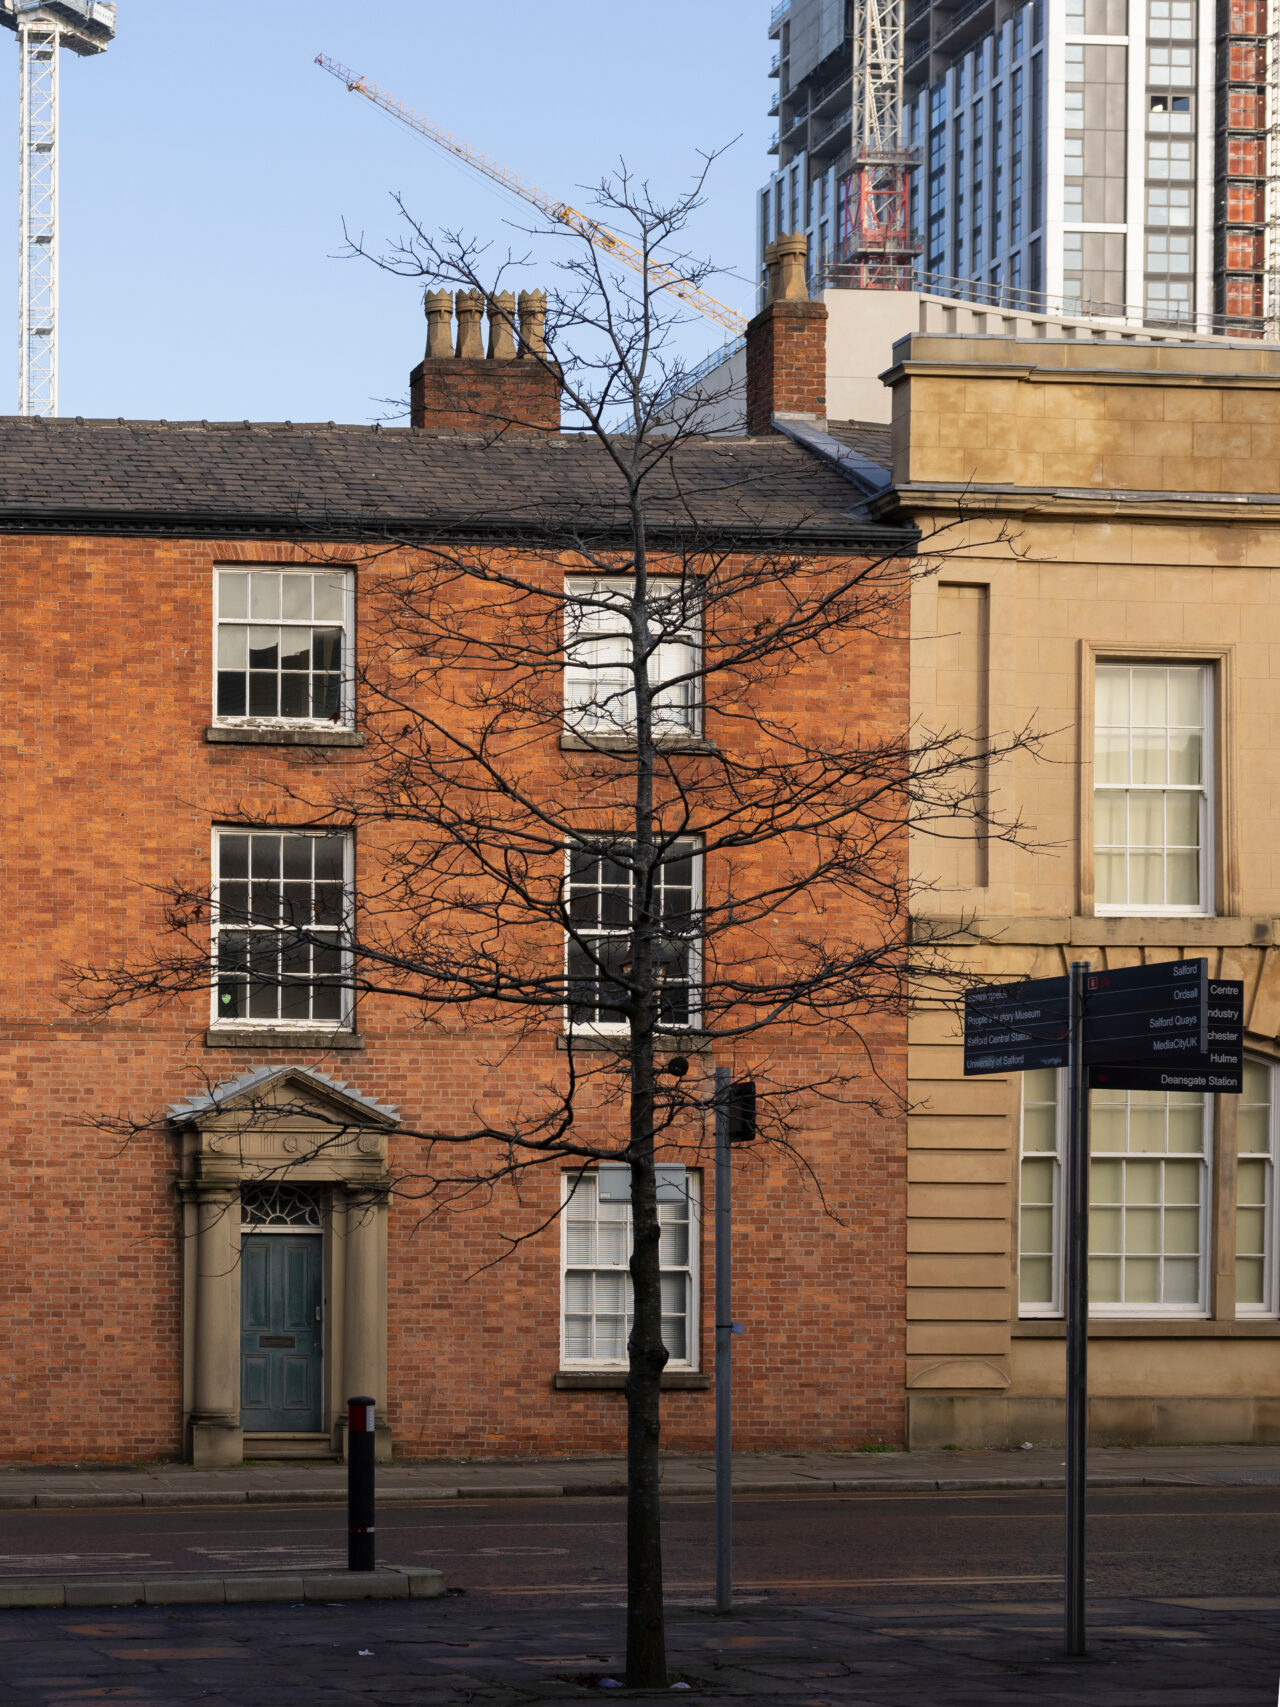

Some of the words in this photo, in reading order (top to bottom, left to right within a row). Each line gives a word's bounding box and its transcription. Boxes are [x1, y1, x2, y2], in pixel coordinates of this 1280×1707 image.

[1173, 965, 1197, 976] Salford
[1173, 988, 1198, 1001] Ordsall
[1210, 985, 1238, 995] Centre
[993, 1012, 1014, 1023] Hstory
[1014, 1010, 1041, 1021] Museum
[1207, 1009, 1239, 1021] ndustry
[1149, 1016, 1174, 1029] Salford
[1175, 1015, 1198, 1028] Quays
[988, 1034, 1010, 1045] Central
[1010, 1032, 1032, 1043] Station
[1153, 1038, 1197, 1050] MediaCityUK
[967, 1056, 996, 1068] University
[996, 1055, 1003, 1066] of
[1003, 1053, 1025, 1066] Salford
[1210, 1053, 1238, 1064] Hulme
[1161, 1074, 1207, 1087] Deansgate
[1208, 1075, 1238, 1087] Station
